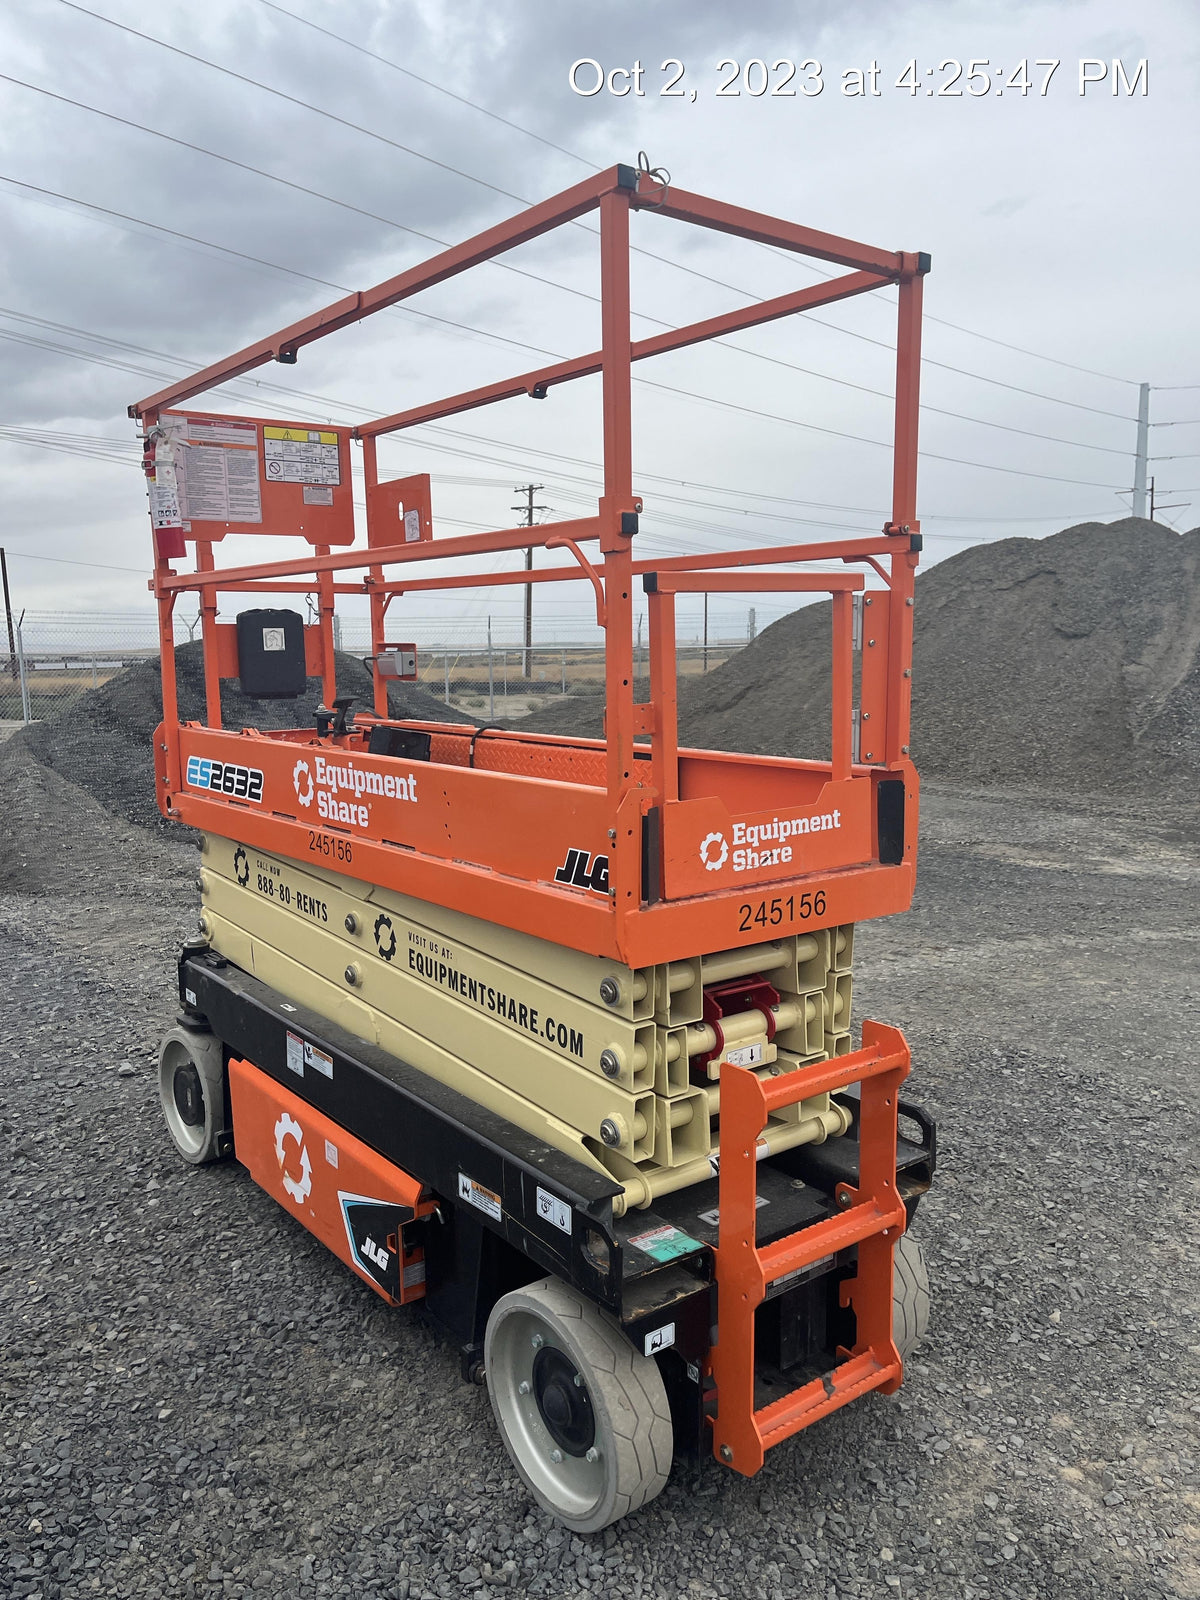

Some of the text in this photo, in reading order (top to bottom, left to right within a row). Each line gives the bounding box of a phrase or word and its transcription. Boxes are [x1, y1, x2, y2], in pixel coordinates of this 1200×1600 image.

[187, 756, 264, 803] ES2632
[314, 757, 417, 802] Equipment
[317, 791, 369, 827] Share
[732, 809, 841, 847] Equipment
[308, 831, 352, 863] 245156
[732, 845, 793, 872] Share
[256, 860, 281, 877] CALL NOW
[554, 848, 609, 895] JLG
[257, 874, 328, 922] 888-80-RENTS
[738, 890, 827, 932] 245156
[408, 931, 453, 960] VISIT US AT:
[408, 948, 584, 1058] EQUIPMENTSHARE.COM
[360, 1236, 390, 1271] JLG
